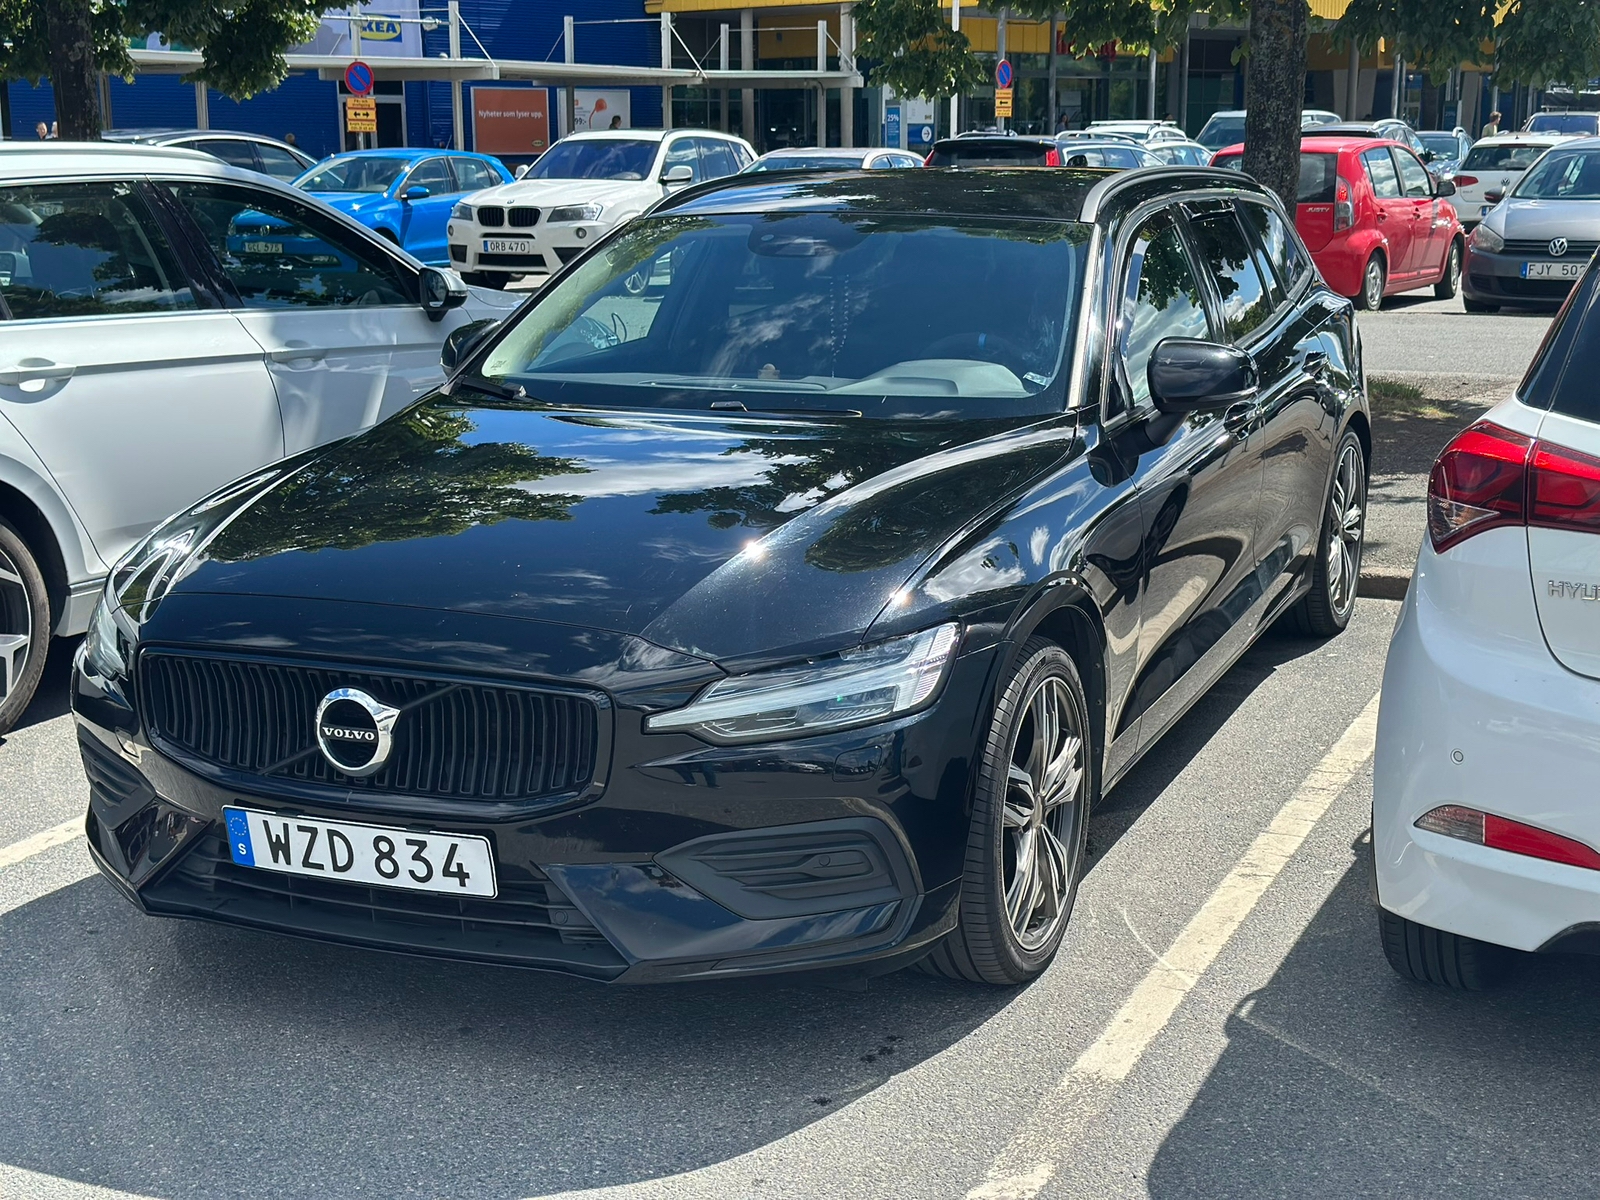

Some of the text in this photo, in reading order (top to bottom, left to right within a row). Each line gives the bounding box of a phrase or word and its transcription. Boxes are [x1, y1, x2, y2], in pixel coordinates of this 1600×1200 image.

[478, 110, 502, 119] Nyheter
[516, 110, 530, 120] lyser
[490, 242, 526, 252] ORB 470
[1528, 264, 1552, 276] FJY
[1548, 579, 1600, 601] HYU
[322, 726, 375, 741] VOLVO
[238, 842, 247, 856] S
[262, 819, 471, 888] WZD 834
